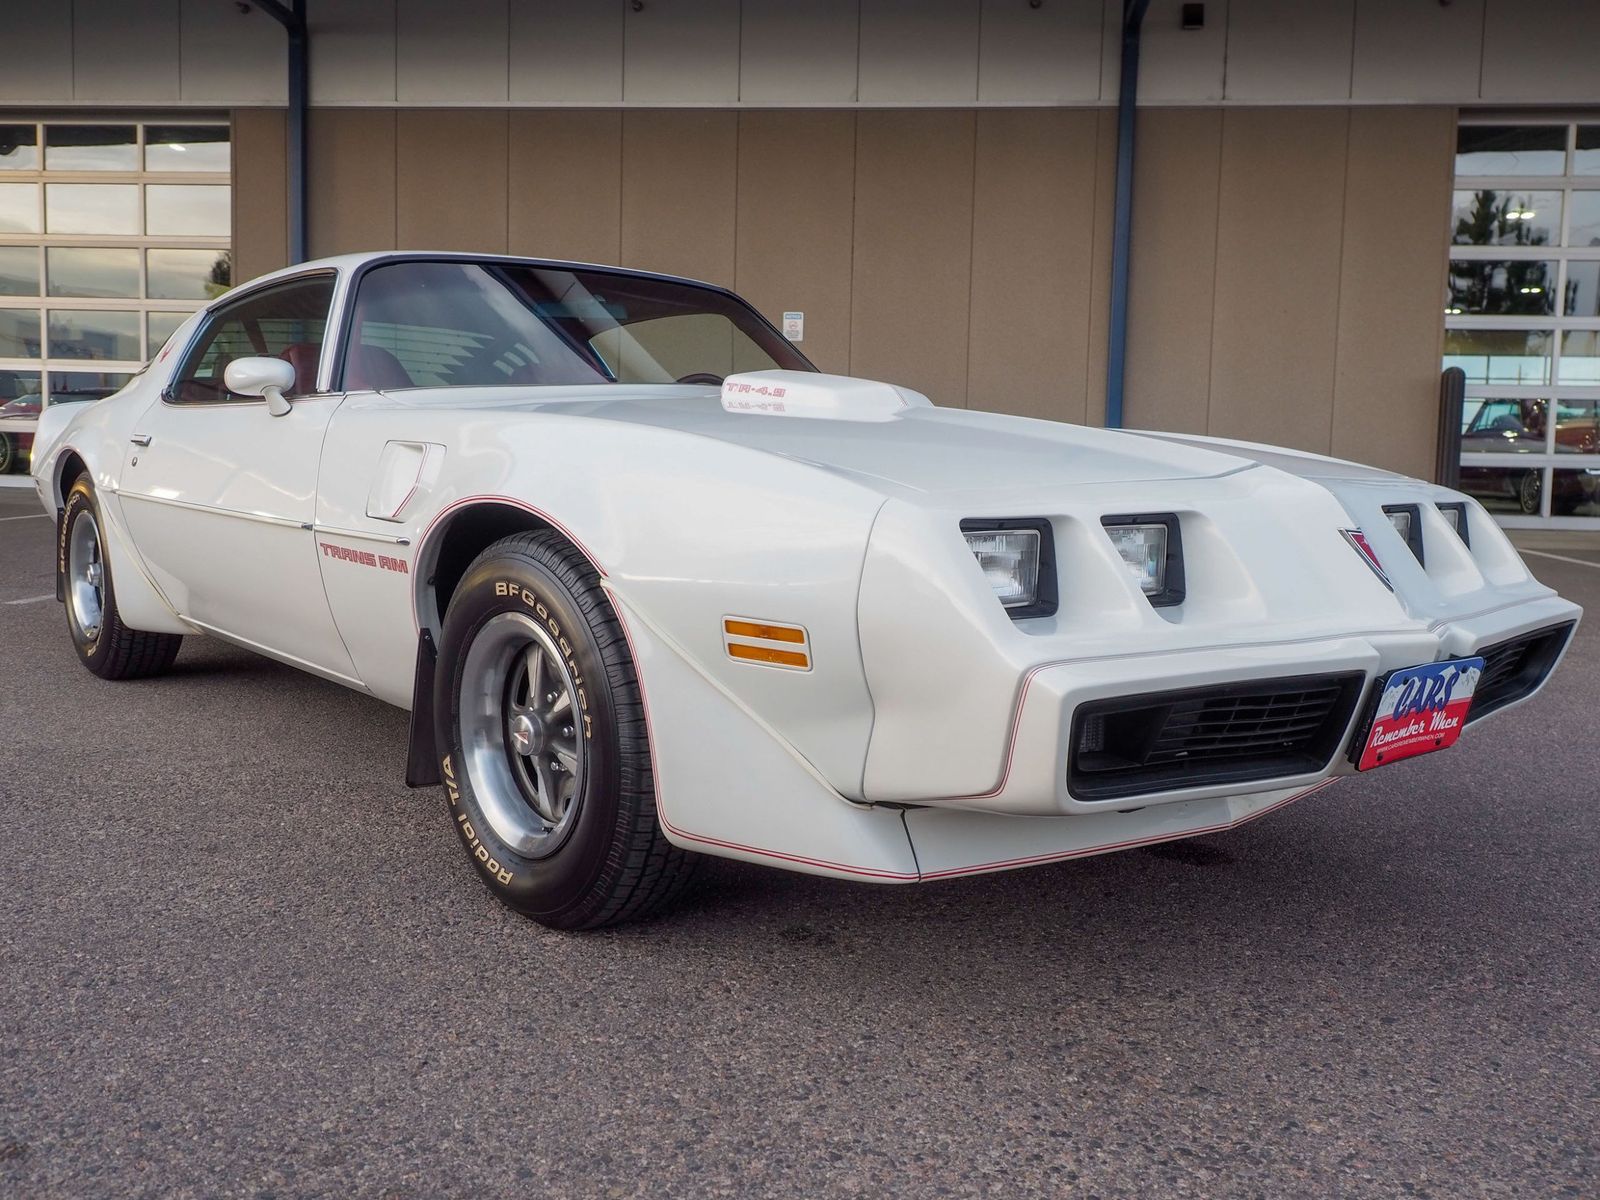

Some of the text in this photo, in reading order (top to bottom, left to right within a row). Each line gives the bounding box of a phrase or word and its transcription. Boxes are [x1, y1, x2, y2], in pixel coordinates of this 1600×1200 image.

[726, 382, 786, 398] TR-4.9
[319, 542, 408, 574] TRANS AM
[1392, 671, 1460, 721] CARS
[1370, 710, 1459, 748] Remember When
[442, 754, 461, 806] T/A
